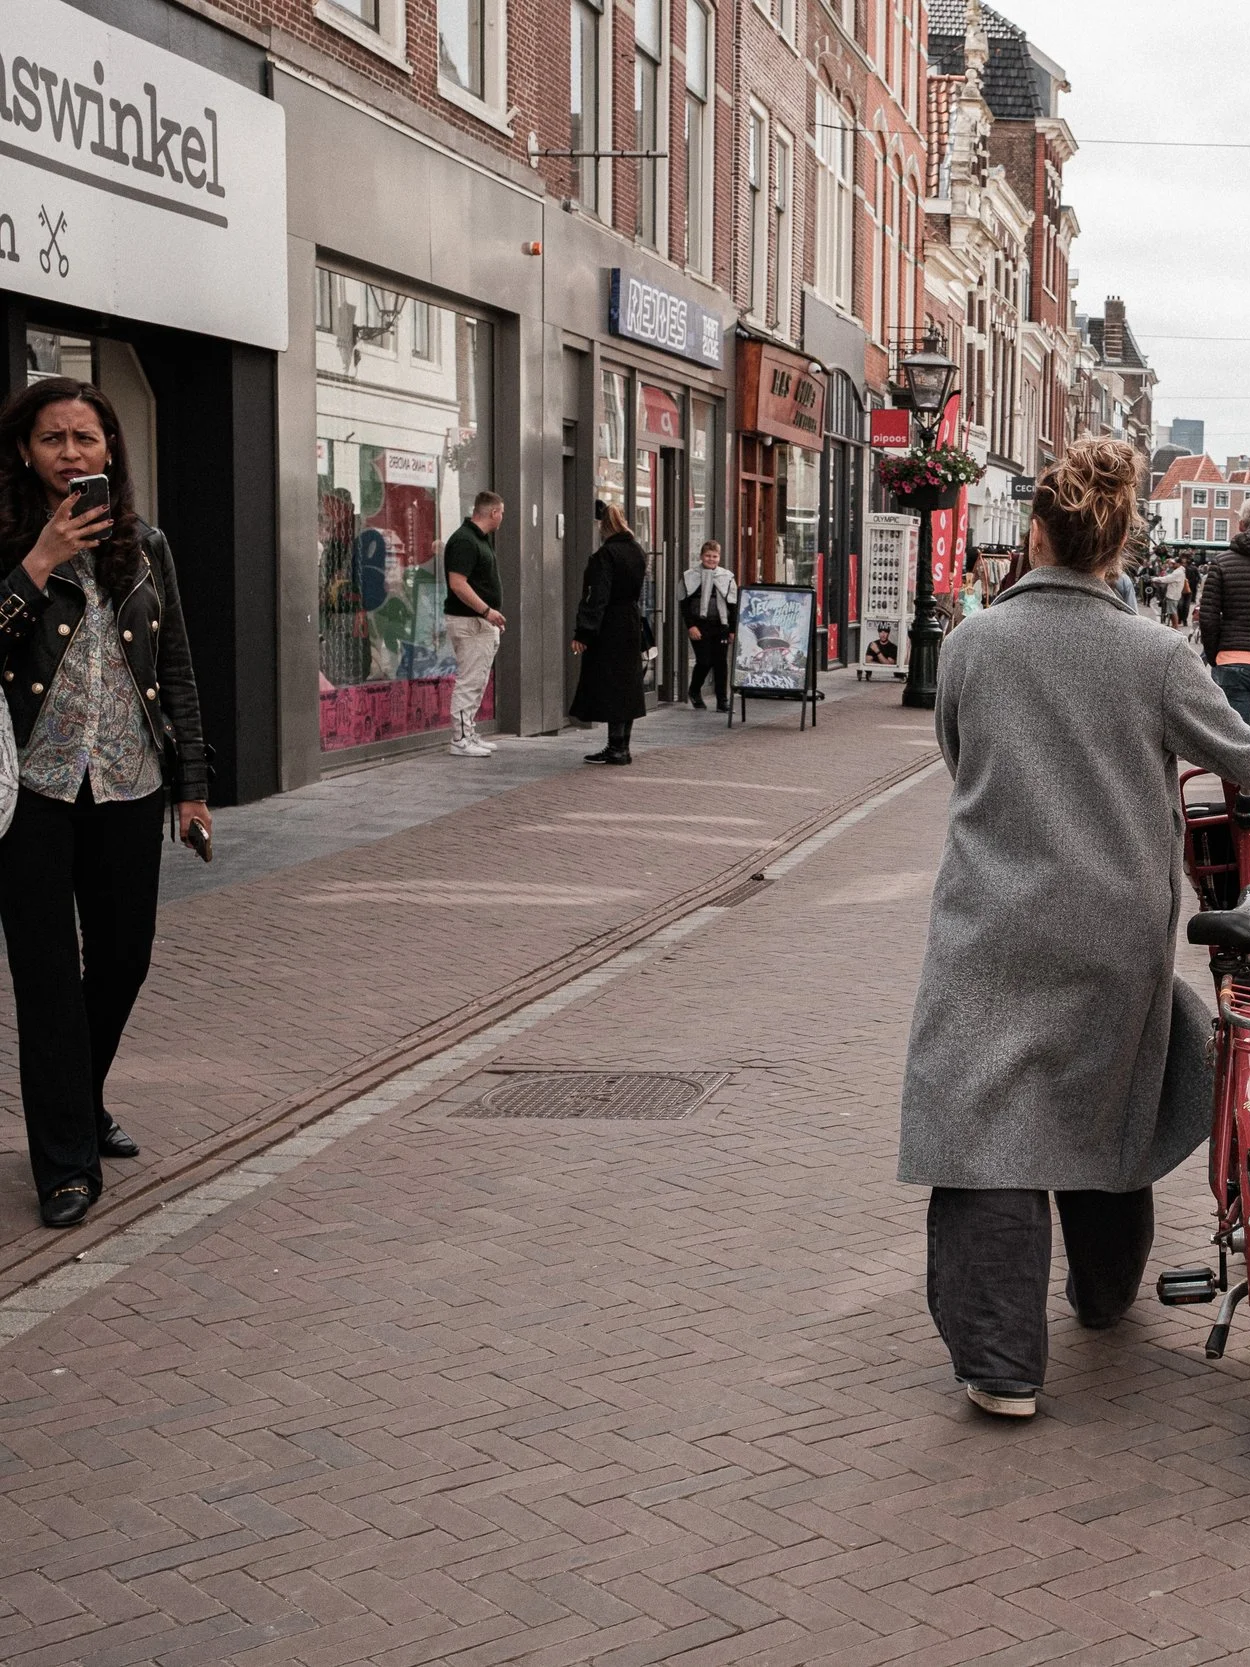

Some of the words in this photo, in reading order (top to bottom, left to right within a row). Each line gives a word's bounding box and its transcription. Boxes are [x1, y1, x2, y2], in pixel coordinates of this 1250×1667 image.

[873, 434, 908, 444] pipoos
[1015, 485, 1036, 493] CECI
[873, 516, 901, 524] OLYMPIC
